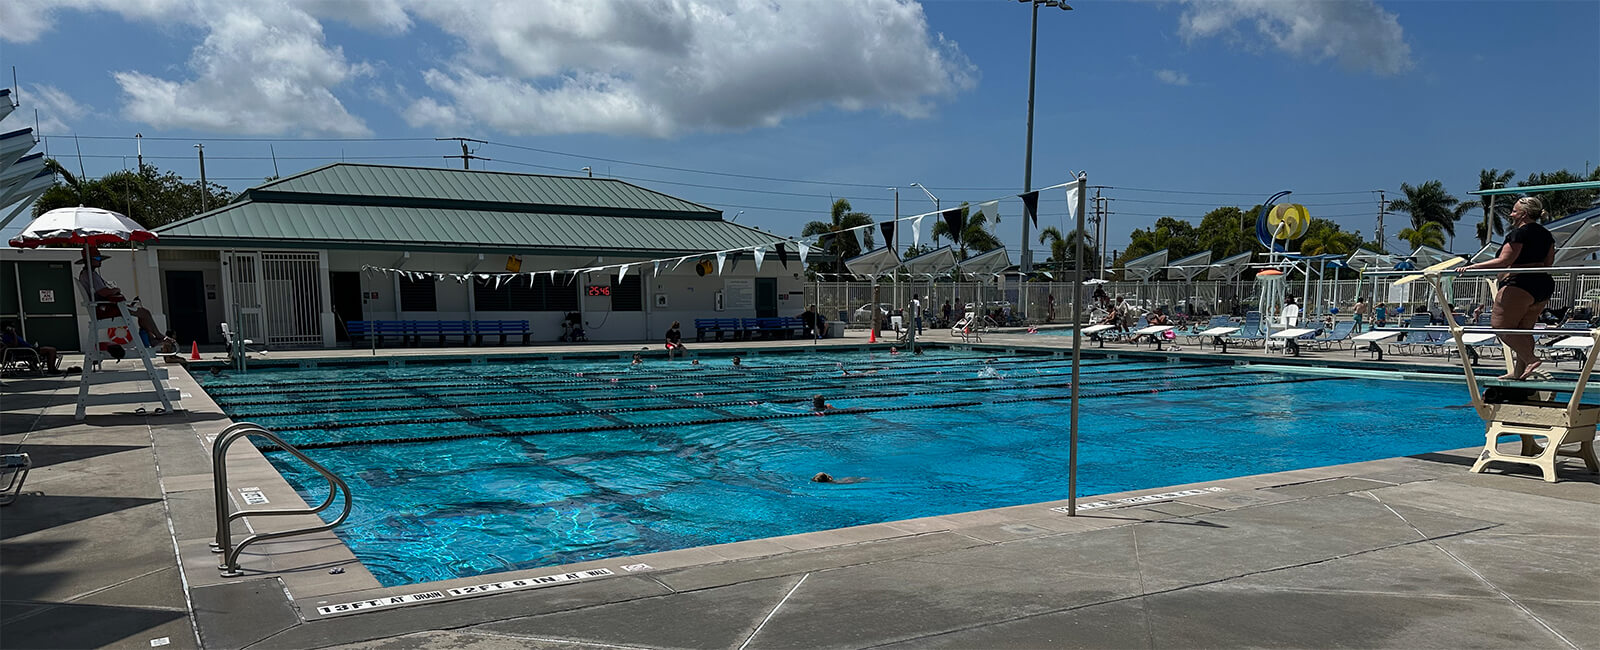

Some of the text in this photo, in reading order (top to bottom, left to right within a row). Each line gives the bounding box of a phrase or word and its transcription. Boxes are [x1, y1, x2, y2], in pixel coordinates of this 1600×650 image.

[586, 568, 610, 577] WALL
[390, 596, 405, 604] AT
[413, 591, 442, 601] DRAIN
